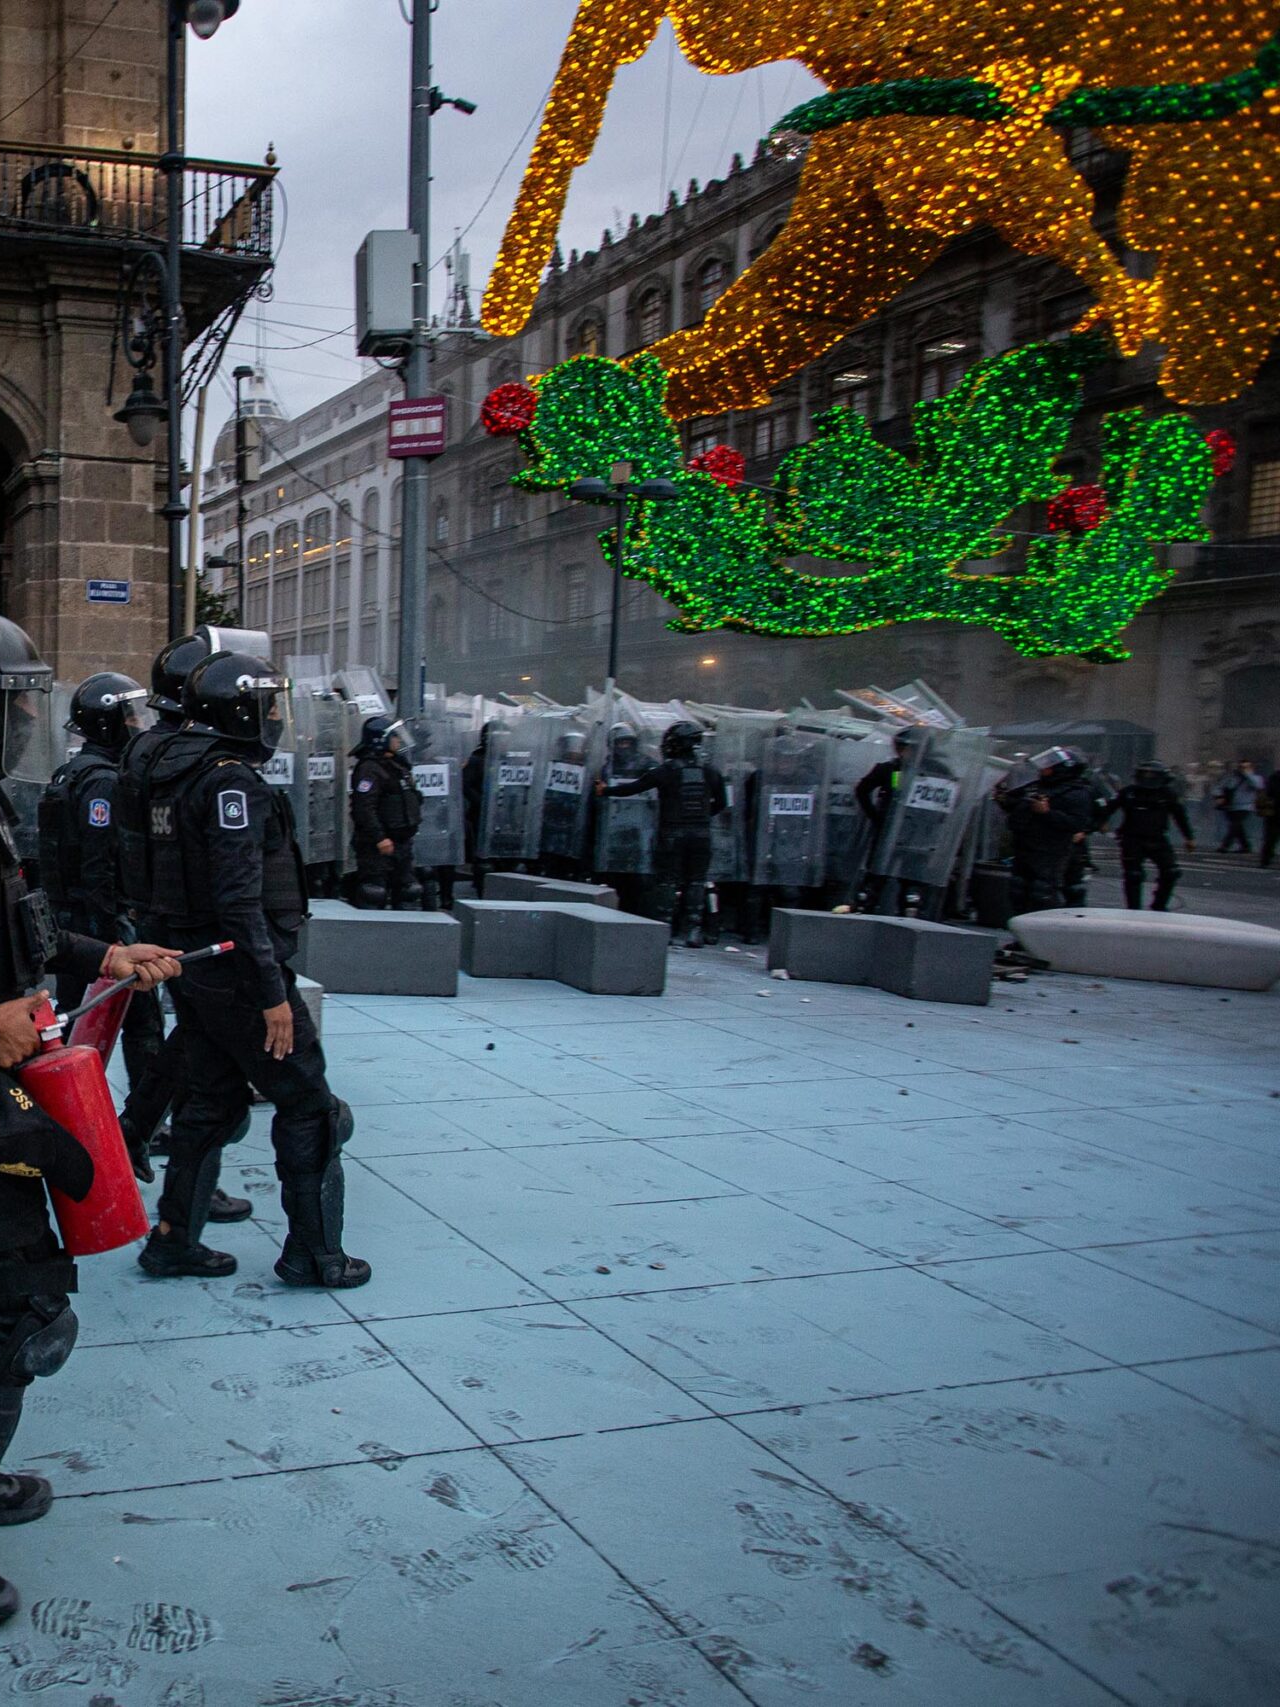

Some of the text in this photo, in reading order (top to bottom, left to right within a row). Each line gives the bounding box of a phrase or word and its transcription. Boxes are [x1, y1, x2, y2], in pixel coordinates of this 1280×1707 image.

[393, 418, 440, 436] 911
[501, 769, 530, 783] POLICIA
[551, 769, 580, 786] POLICIA
[915, 784, 952, 804] POLICIA
[773, 797, 809, 812] POLICIA
[151, 806, 172, 835] SSC
[9, 1087, 34, 1111] SSC
